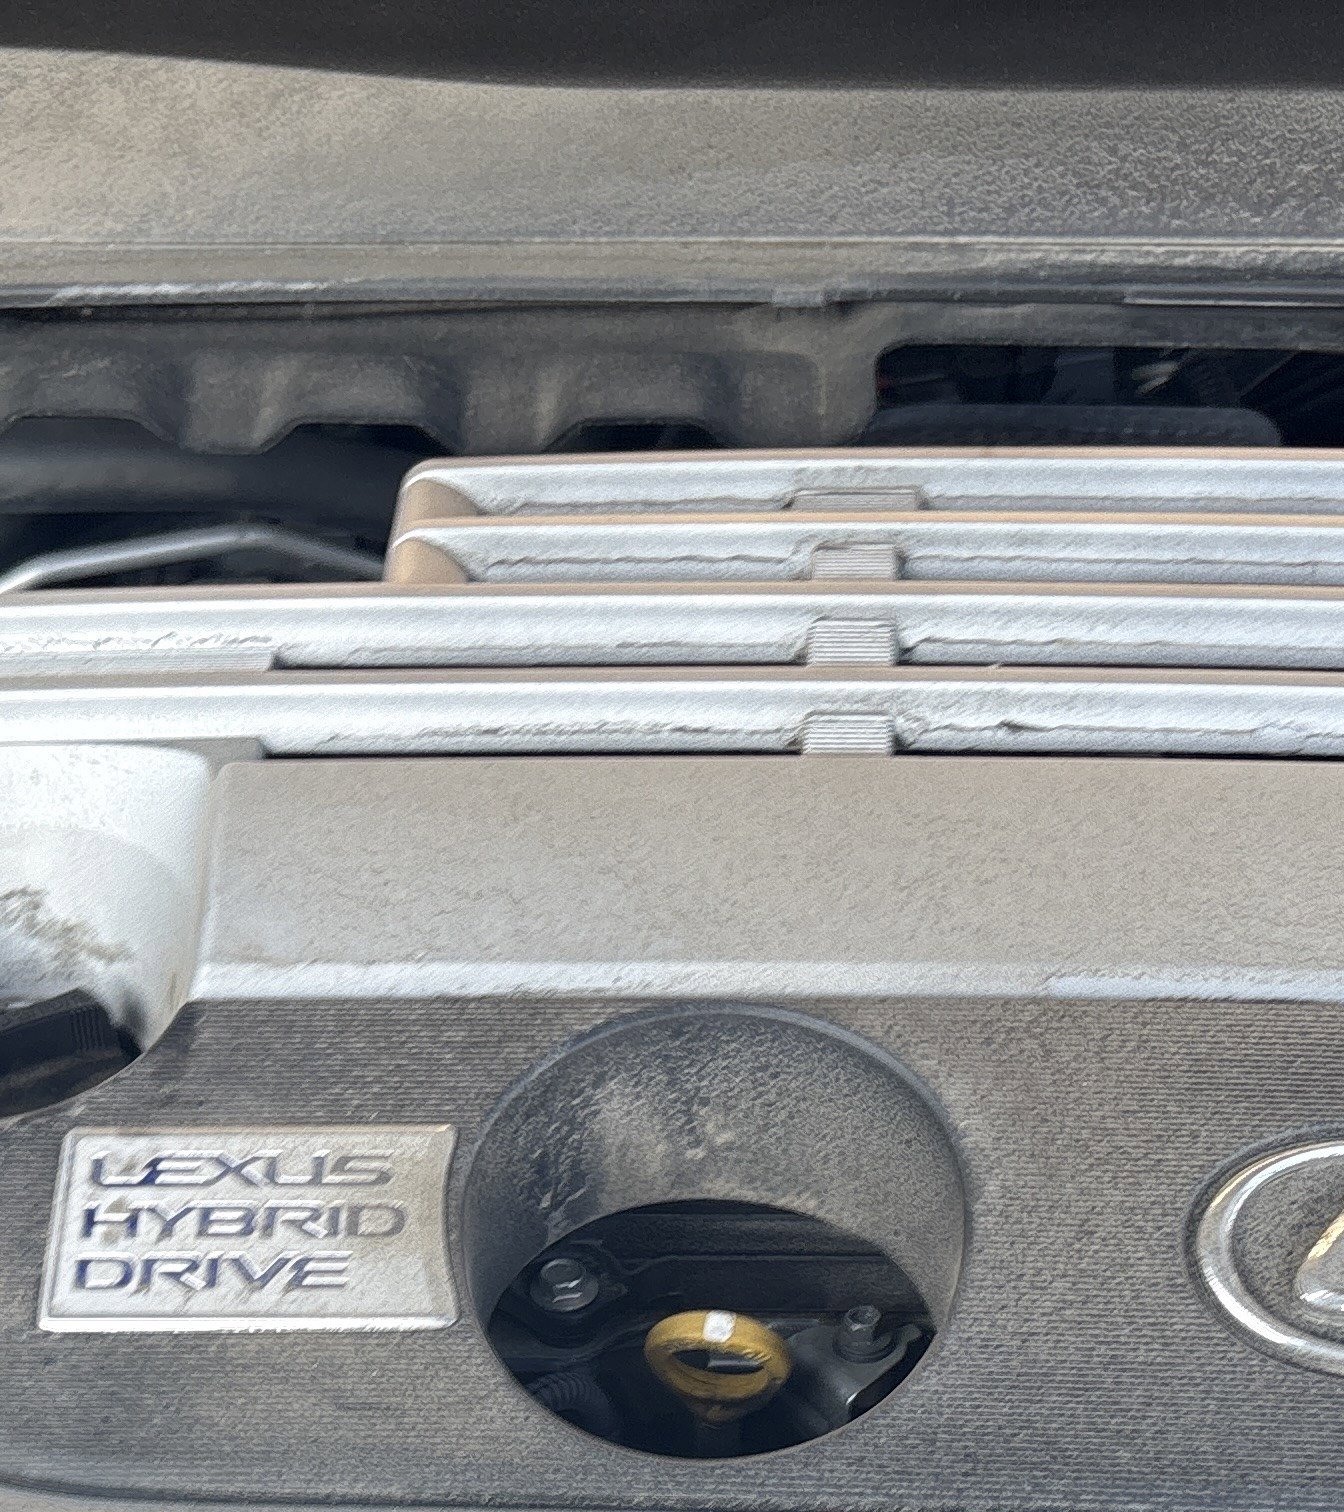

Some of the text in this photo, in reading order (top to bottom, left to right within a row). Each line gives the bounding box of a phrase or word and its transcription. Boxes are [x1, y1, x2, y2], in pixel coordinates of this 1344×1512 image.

[90, 1148, 395, 1188] LEXUS
[77, 1198, 407, 1240] HYBRID
[72, 1249, 356, 1293] DRIVE
